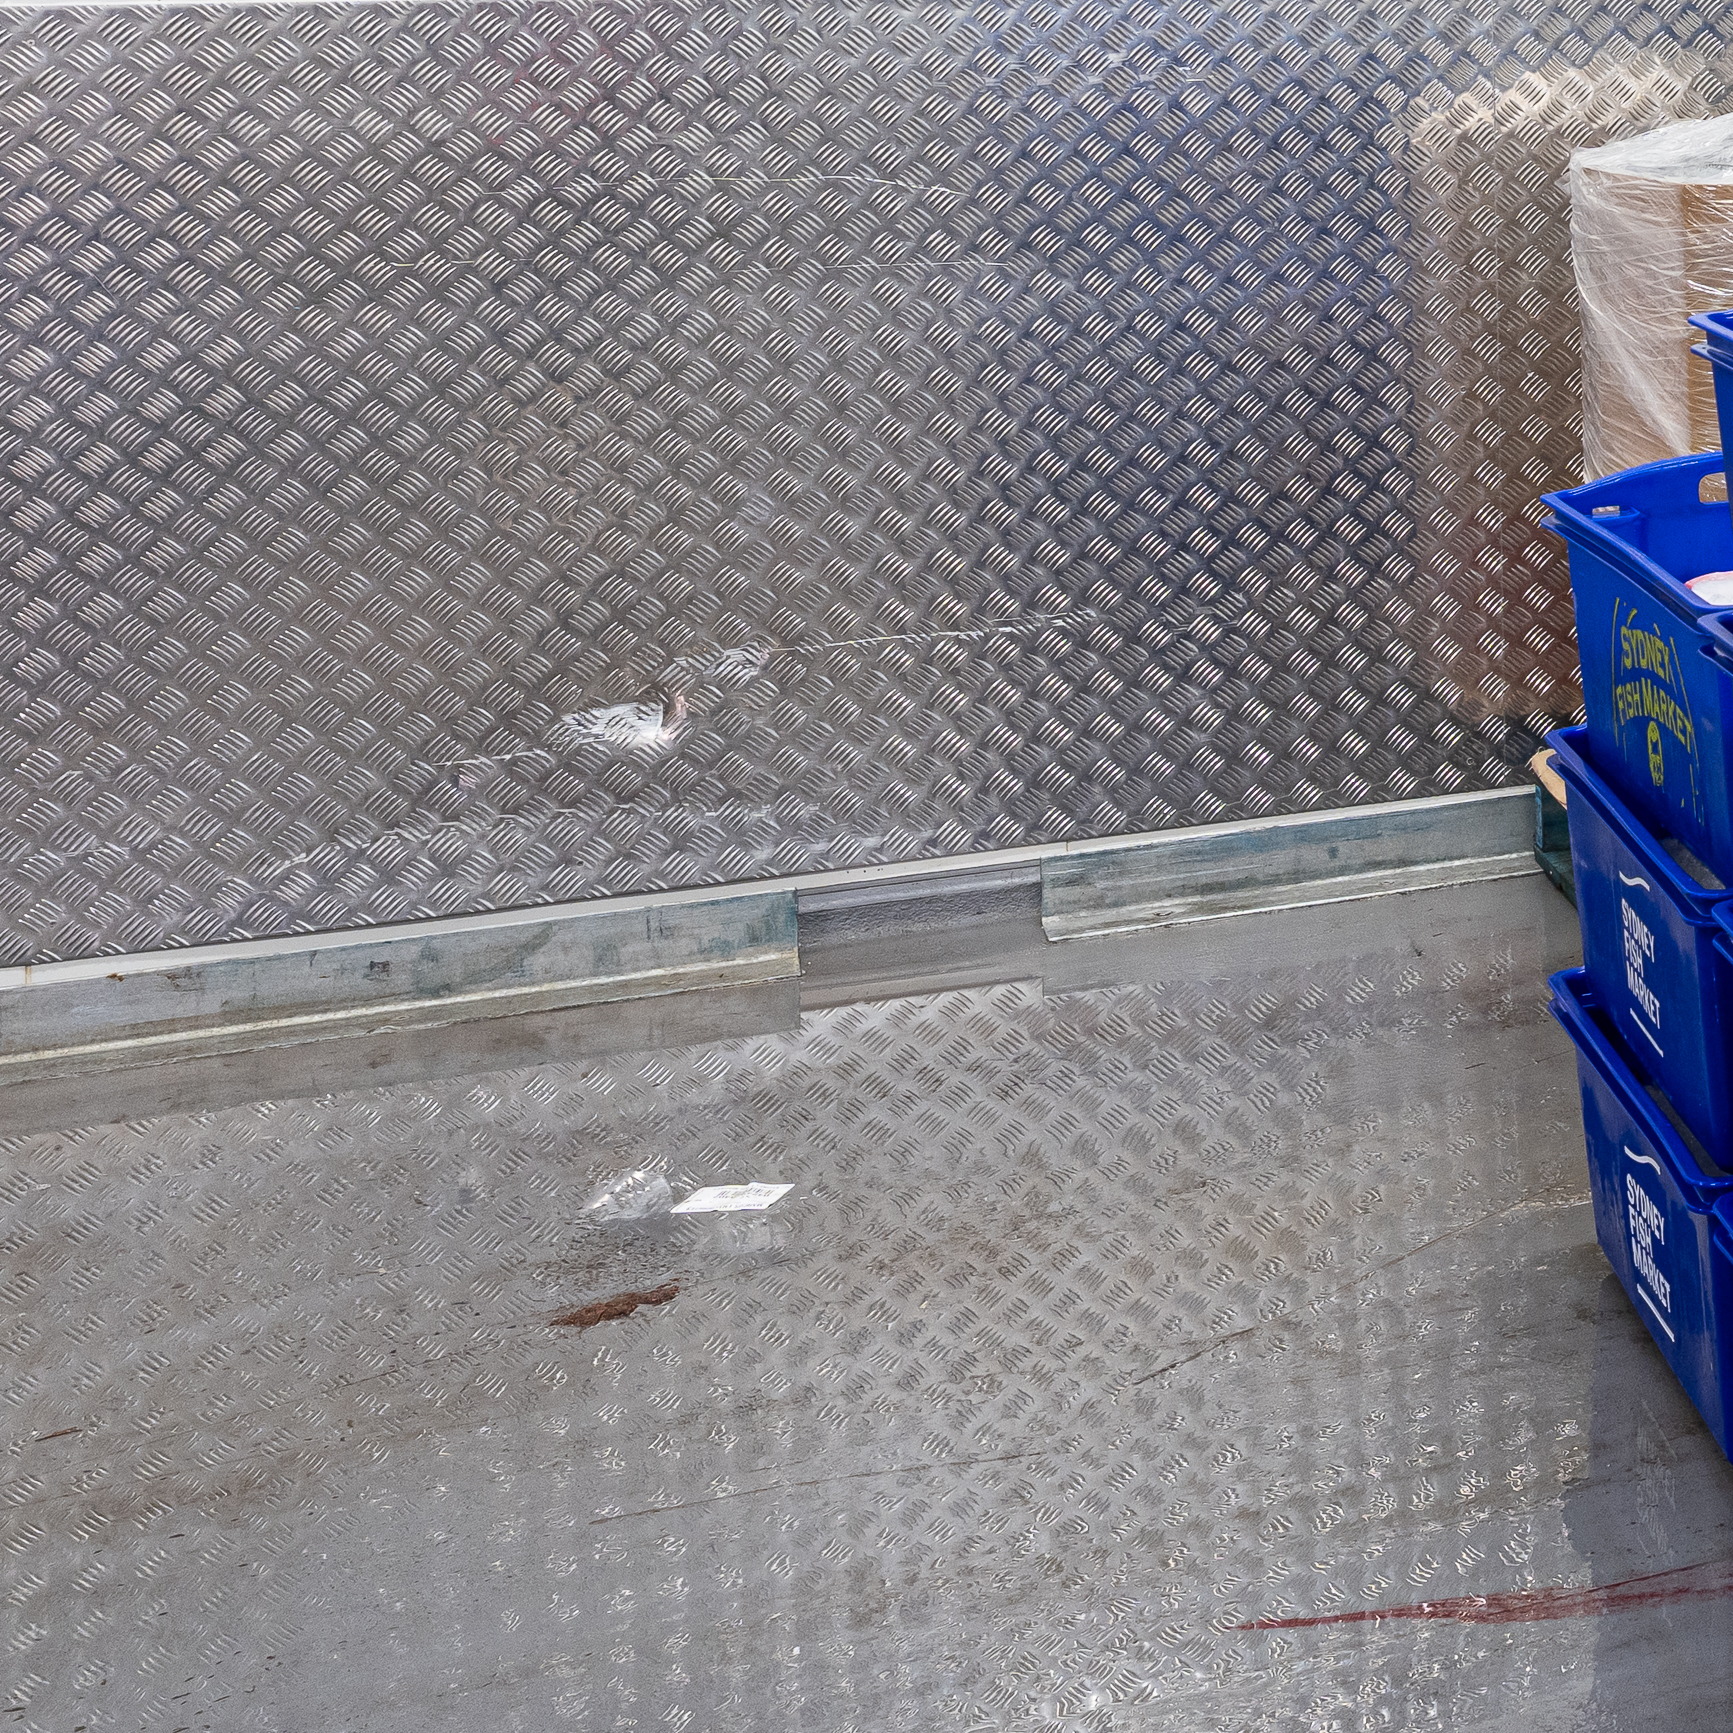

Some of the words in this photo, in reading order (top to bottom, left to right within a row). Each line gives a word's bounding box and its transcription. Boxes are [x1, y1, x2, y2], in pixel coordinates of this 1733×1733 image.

[1620, 625, 1671, 684] SYDNEY
[1616, 681, 1642, 726] FISH
[1640, 677, 1692, 754] MARKET
[1621, 897, 1655, 963] SYDNEY
[1623, 928, 1644, 978] FISH
[1626, 960, 1661, 1029] MARKET
[1626, 1173, 1665, 1246] SYDNEY
[1628, 1204, 1653, 1259] FISH
[1631, 1236, 1671, 1313] MARKET
